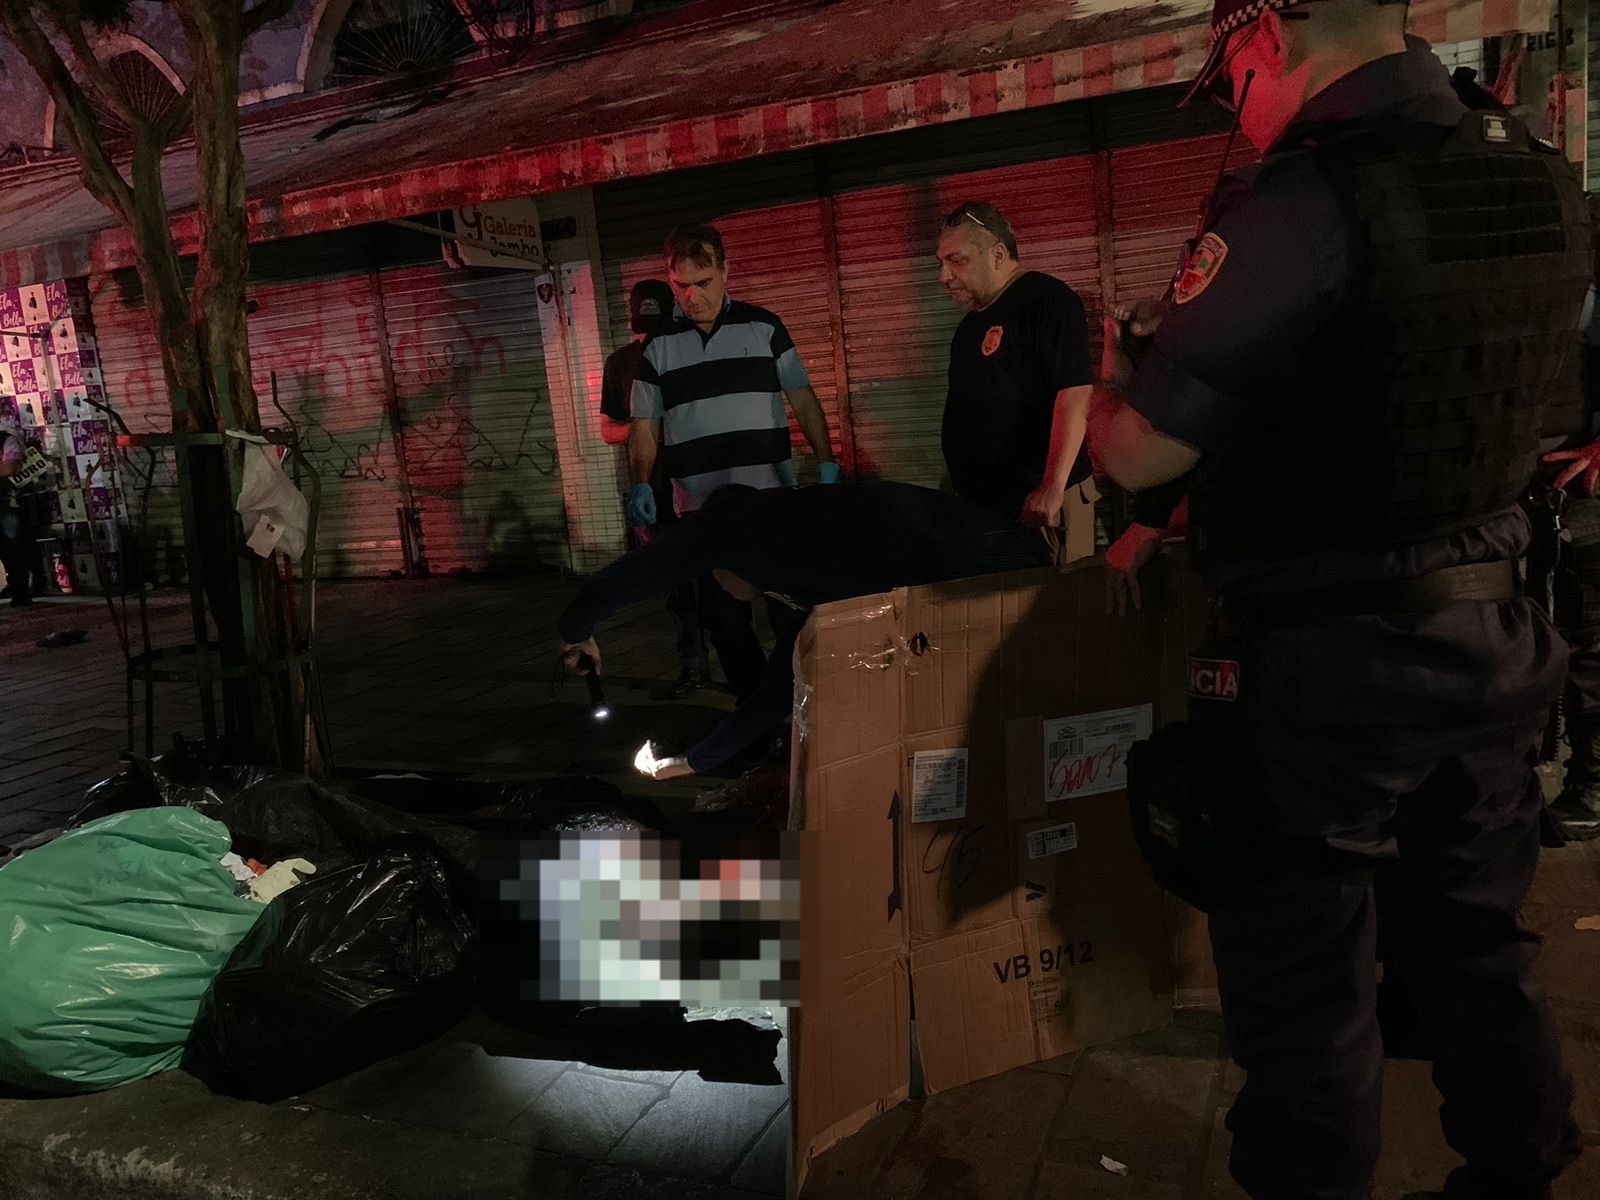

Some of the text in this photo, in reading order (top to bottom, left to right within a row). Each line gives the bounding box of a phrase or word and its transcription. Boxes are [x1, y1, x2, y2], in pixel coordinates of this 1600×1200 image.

[484, 215, 537, 238] Galeria
[993, 940, 1094, 983] VB 9/12
